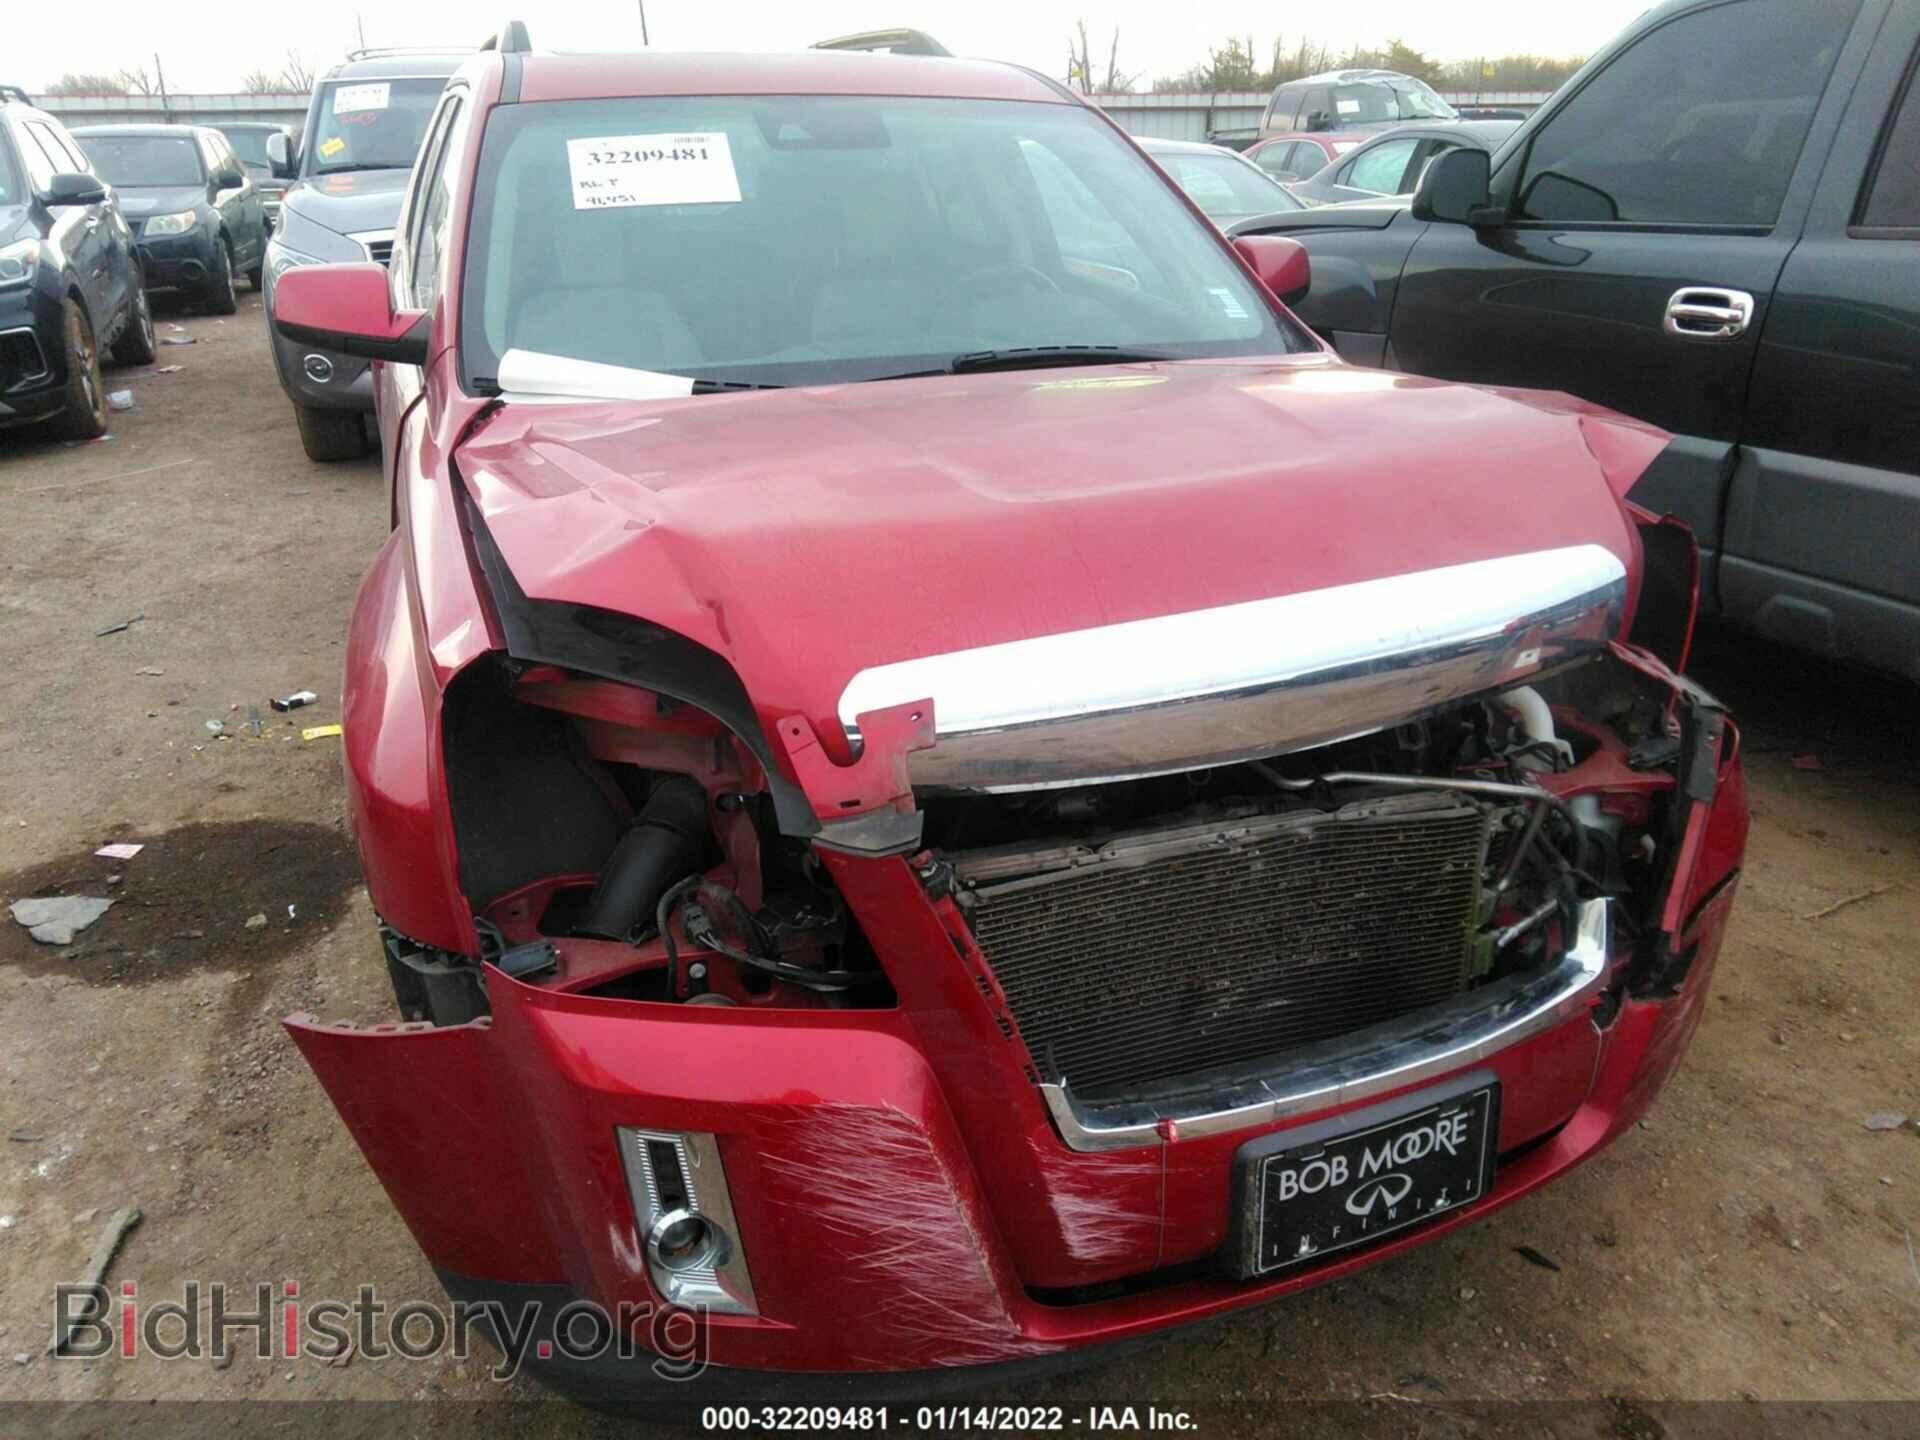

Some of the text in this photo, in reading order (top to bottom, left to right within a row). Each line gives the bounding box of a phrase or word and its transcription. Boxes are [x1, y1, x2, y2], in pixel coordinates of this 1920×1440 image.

[587, 148, 709, 166] 32209481
[1280, 1111, 1470, 1201] BOB MOORE
